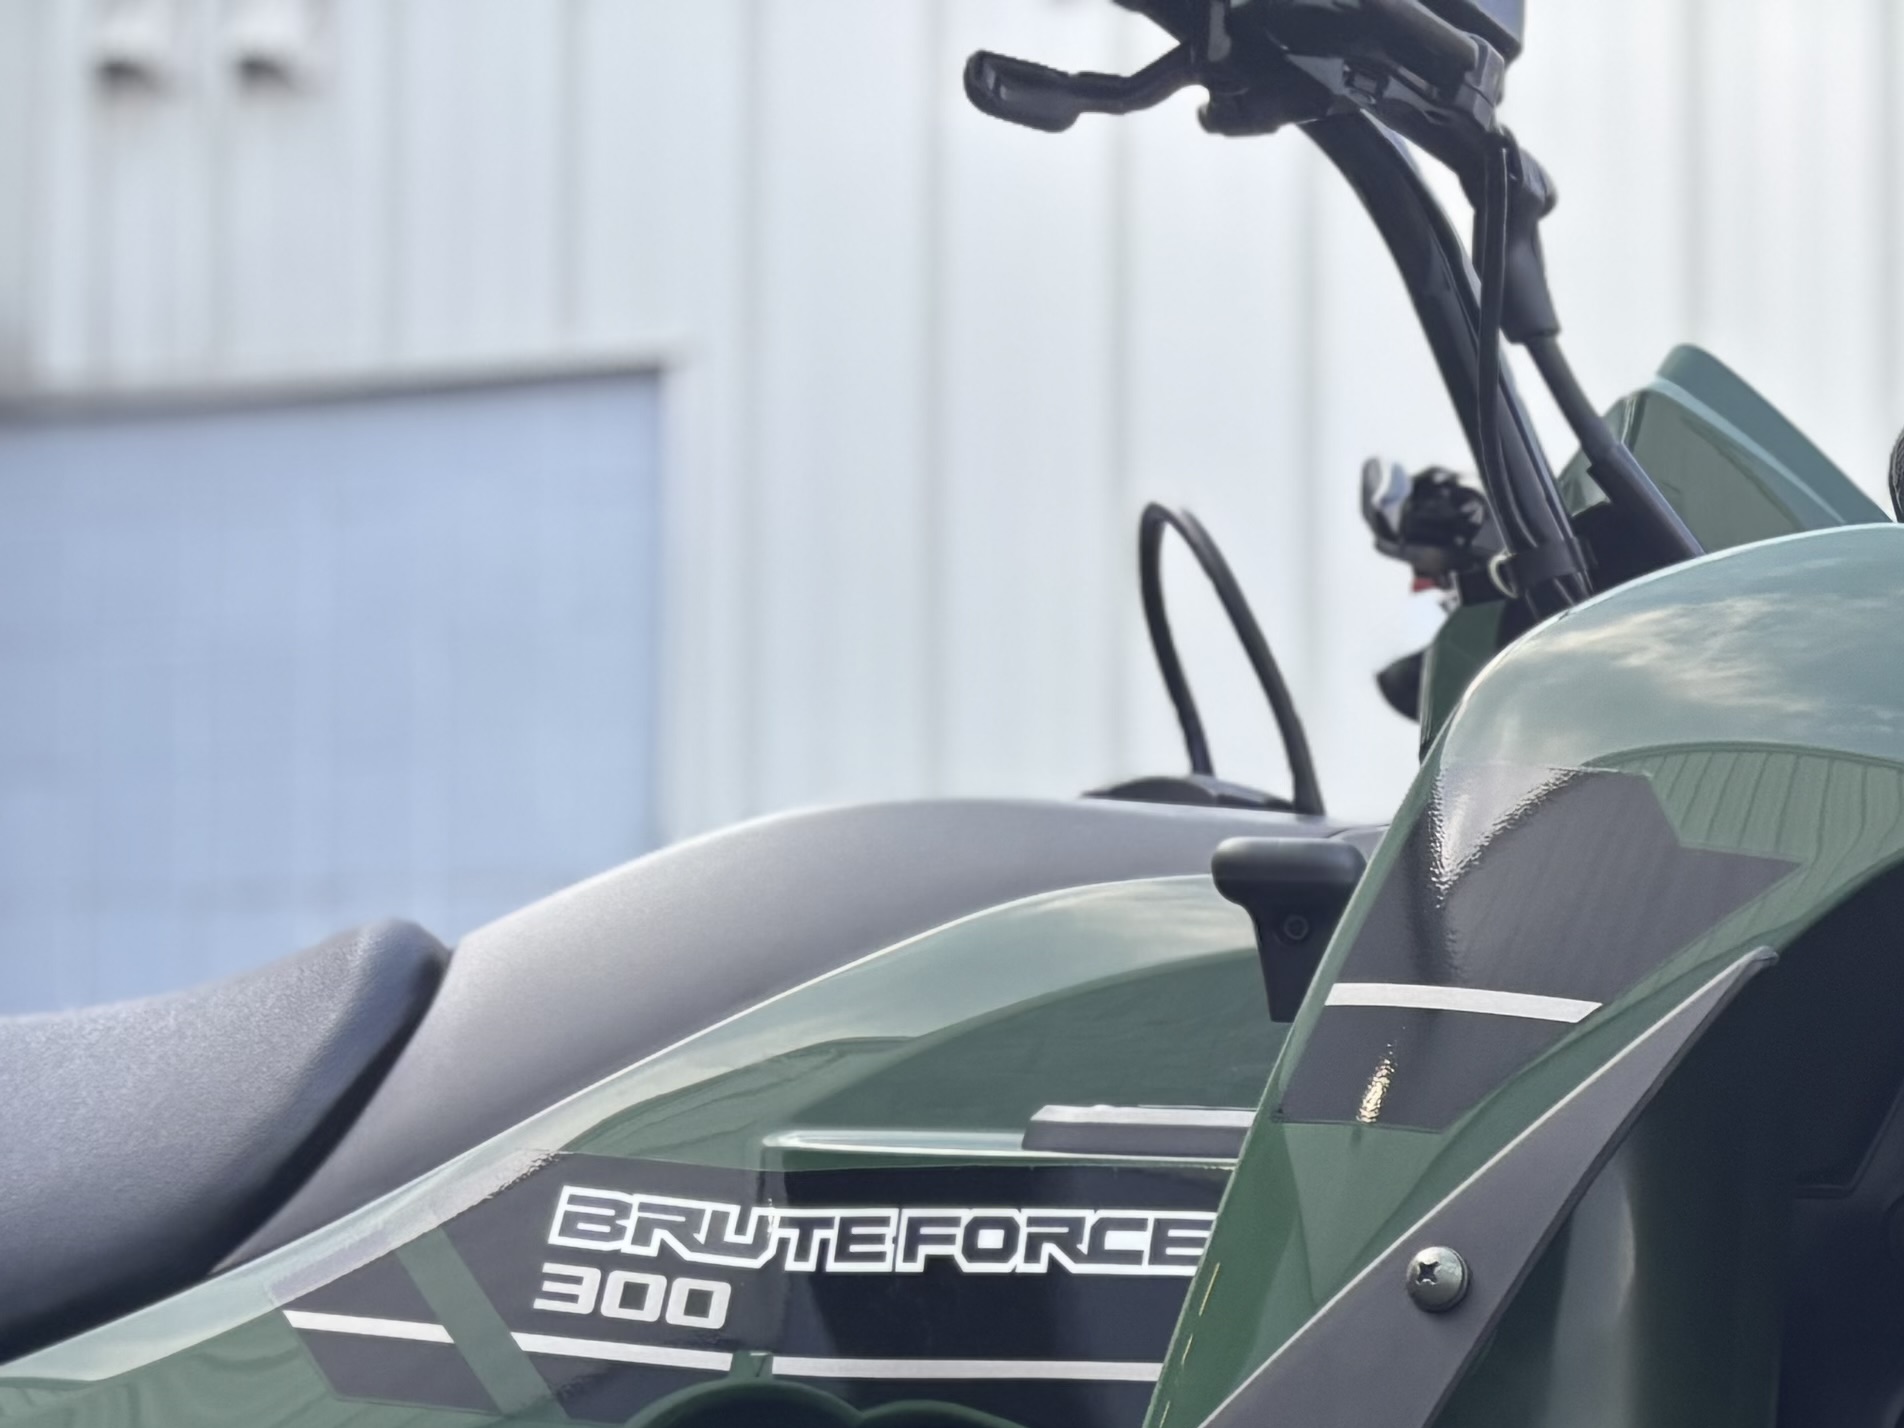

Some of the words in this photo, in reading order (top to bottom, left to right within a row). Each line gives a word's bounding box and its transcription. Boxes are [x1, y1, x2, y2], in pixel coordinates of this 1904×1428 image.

[548, 1186, 898, 1272] BRUTE
[895, 1208, 1217, 1276] FORCE
[533, 1263, 731, 1329] 300
